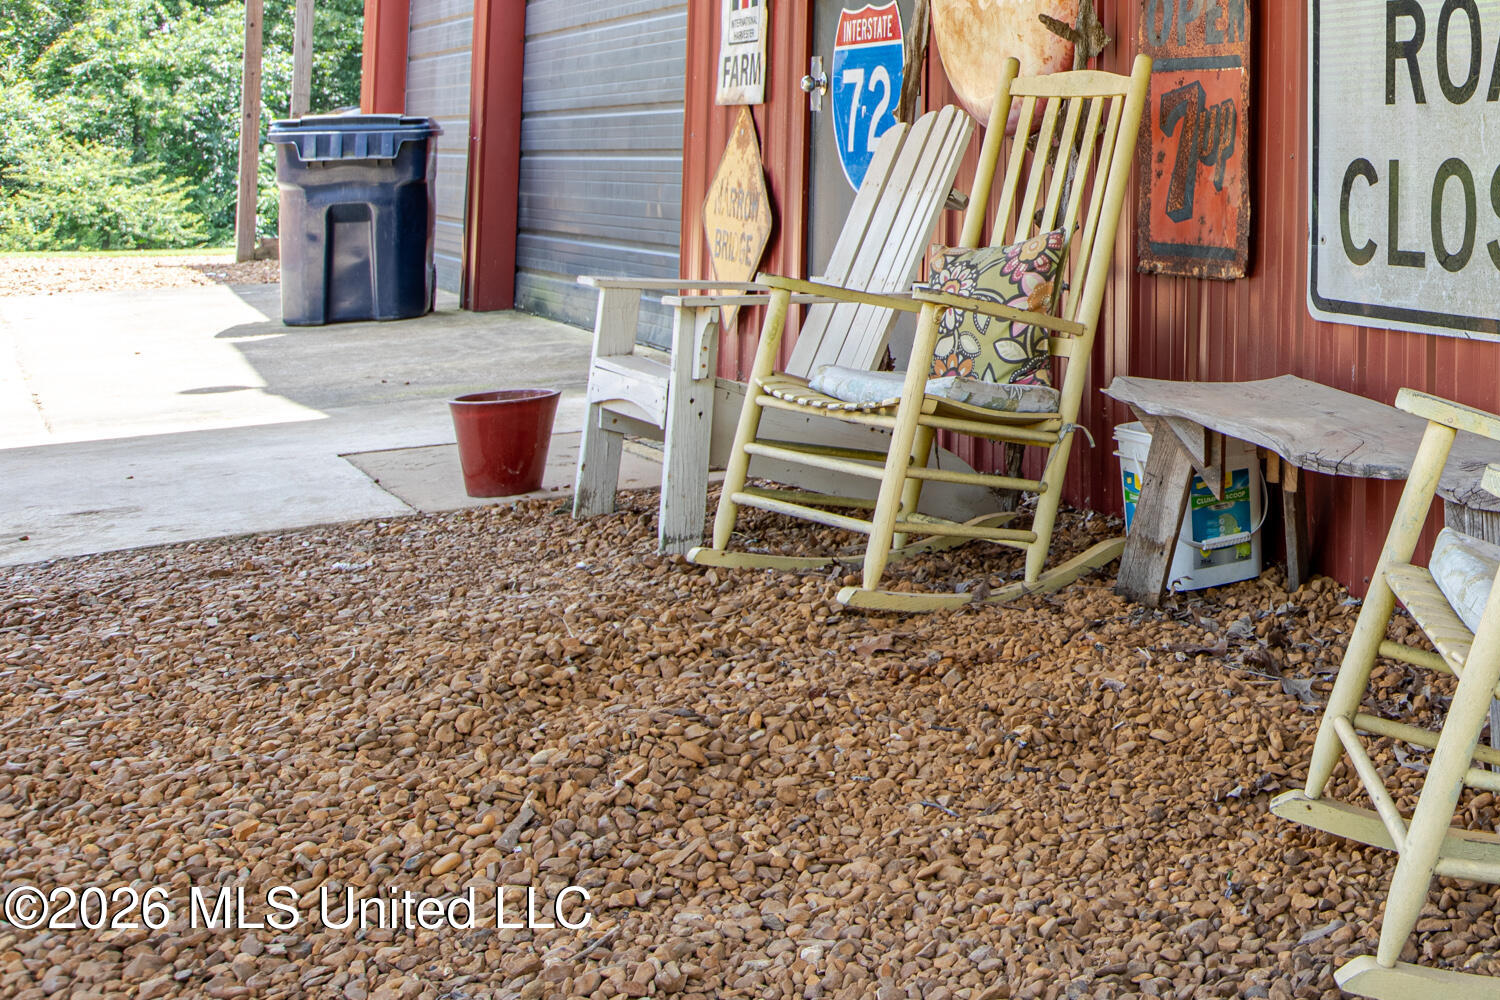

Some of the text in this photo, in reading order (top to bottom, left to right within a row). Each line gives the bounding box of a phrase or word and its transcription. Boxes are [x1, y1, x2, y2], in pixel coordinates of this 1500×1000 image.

[731, 15, 758, 30] INTERNATIONAL
[843, 15, 893, 42] INTERSTATE
[723, 52, 761, 88] FARM
[842, 65, 891, 152] 72
[715, 228, 753, 266] BRIDGE
